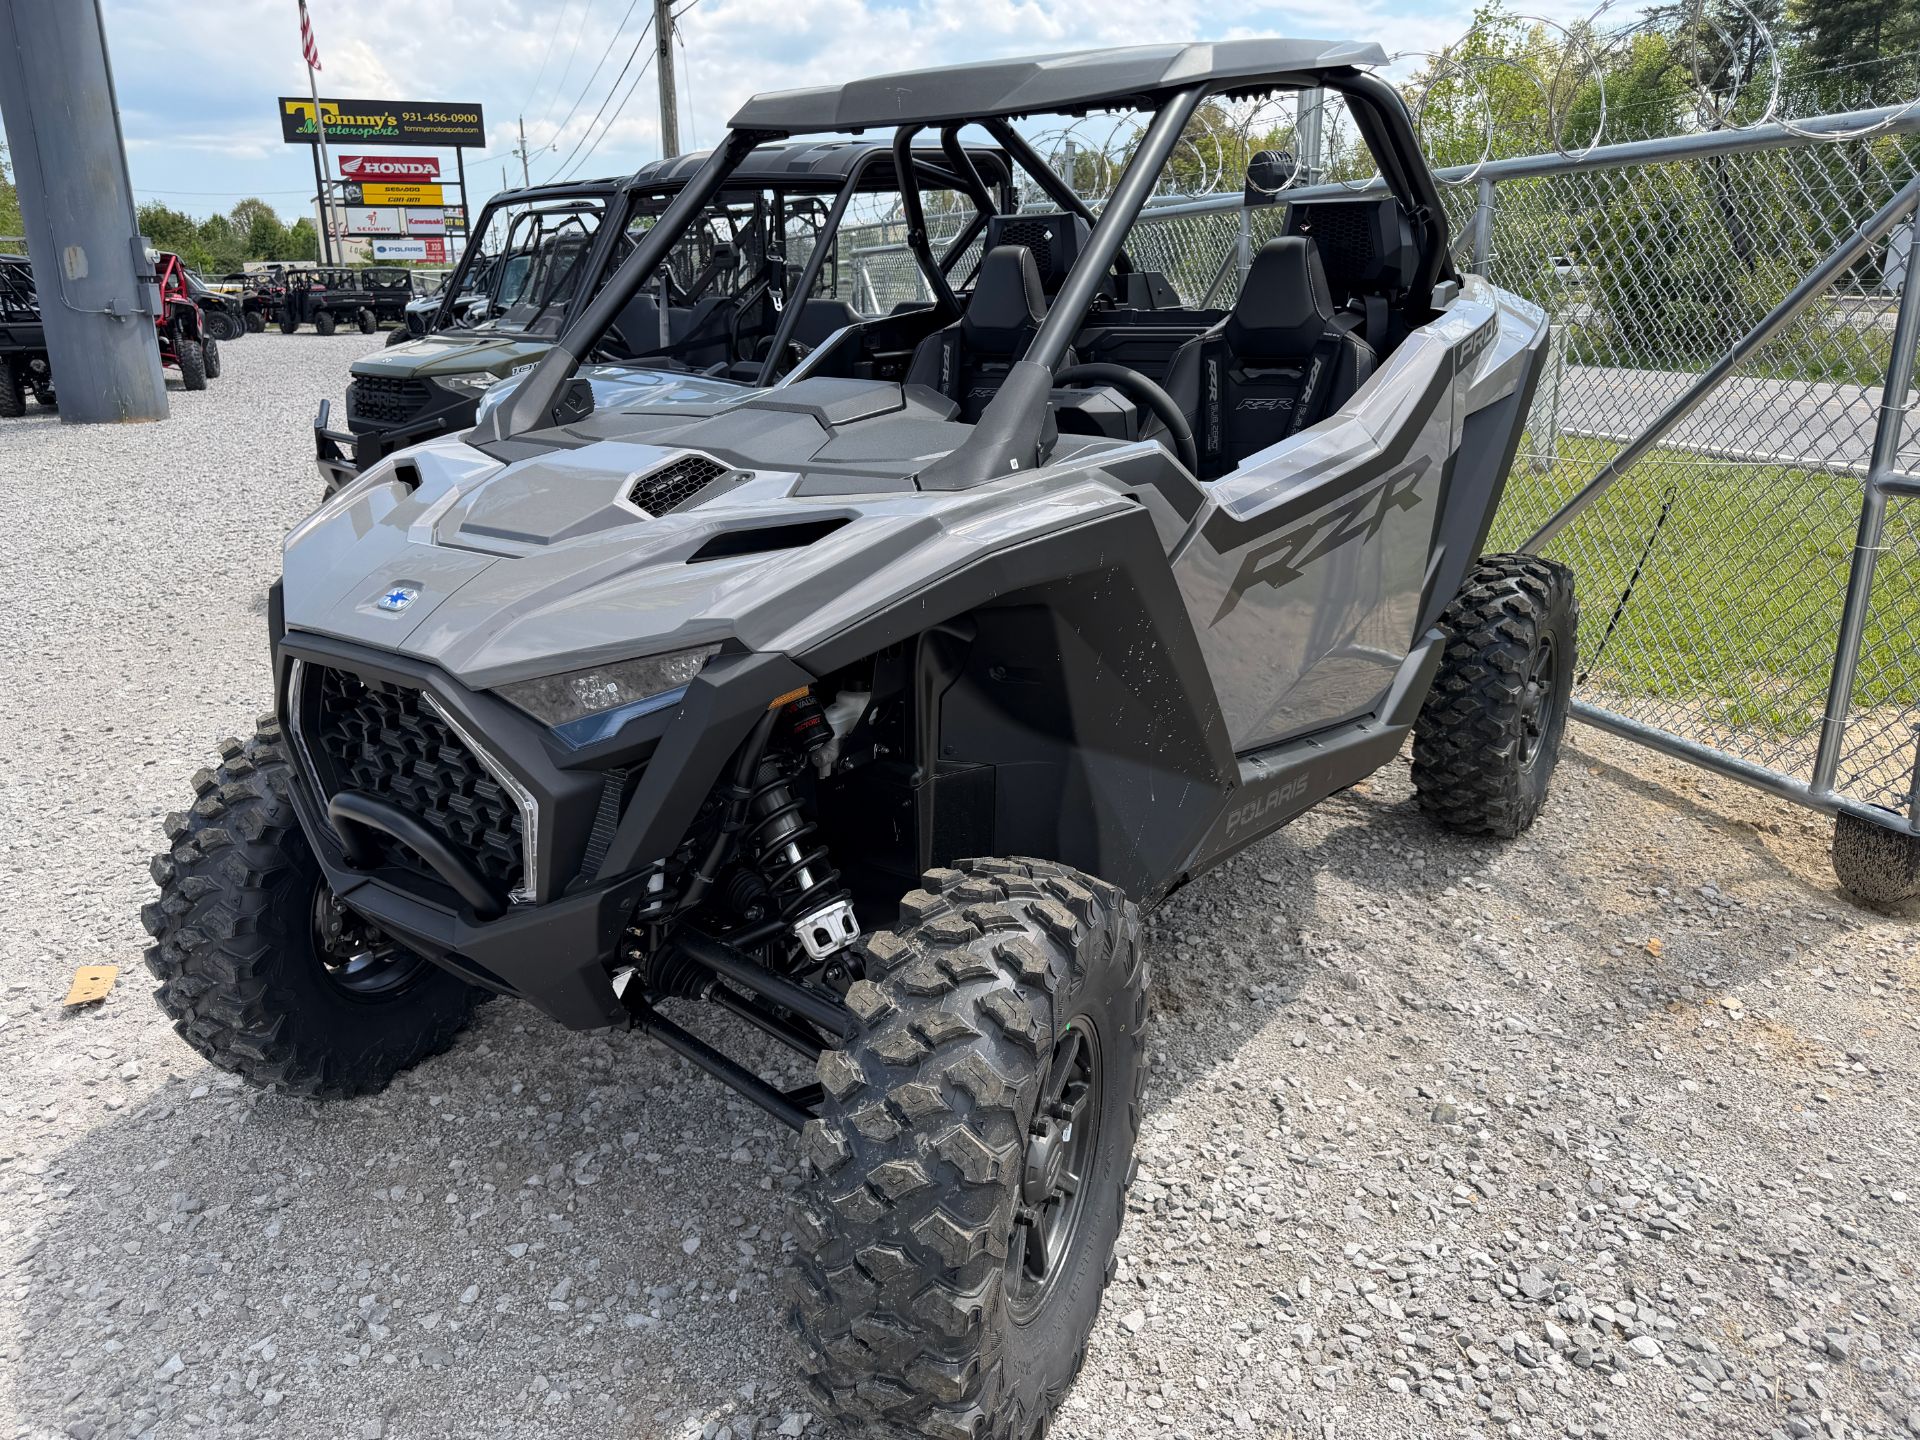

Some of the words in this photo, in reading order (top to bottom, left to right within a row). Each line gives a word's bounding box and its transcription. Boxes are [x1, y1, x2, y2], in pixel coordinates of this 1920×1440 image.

[285, 101, 398, 130] Tommy's
[402, 112, 478, 123] 931-456-0900
[296, 118, 400, 138] Motorsports
[404, 125, 479, 134] tommysmotorsports.com
[363, 163, 439, 174] HONDA
[1207, 359, 1218, 402] RZR
[1301, 357, 1322, 404] RZR
[1235, 398, 1295, 411] RZR
[1207, 454, 1434, 631] RZR
[1224, 772, 1310, 835] POLARIS
